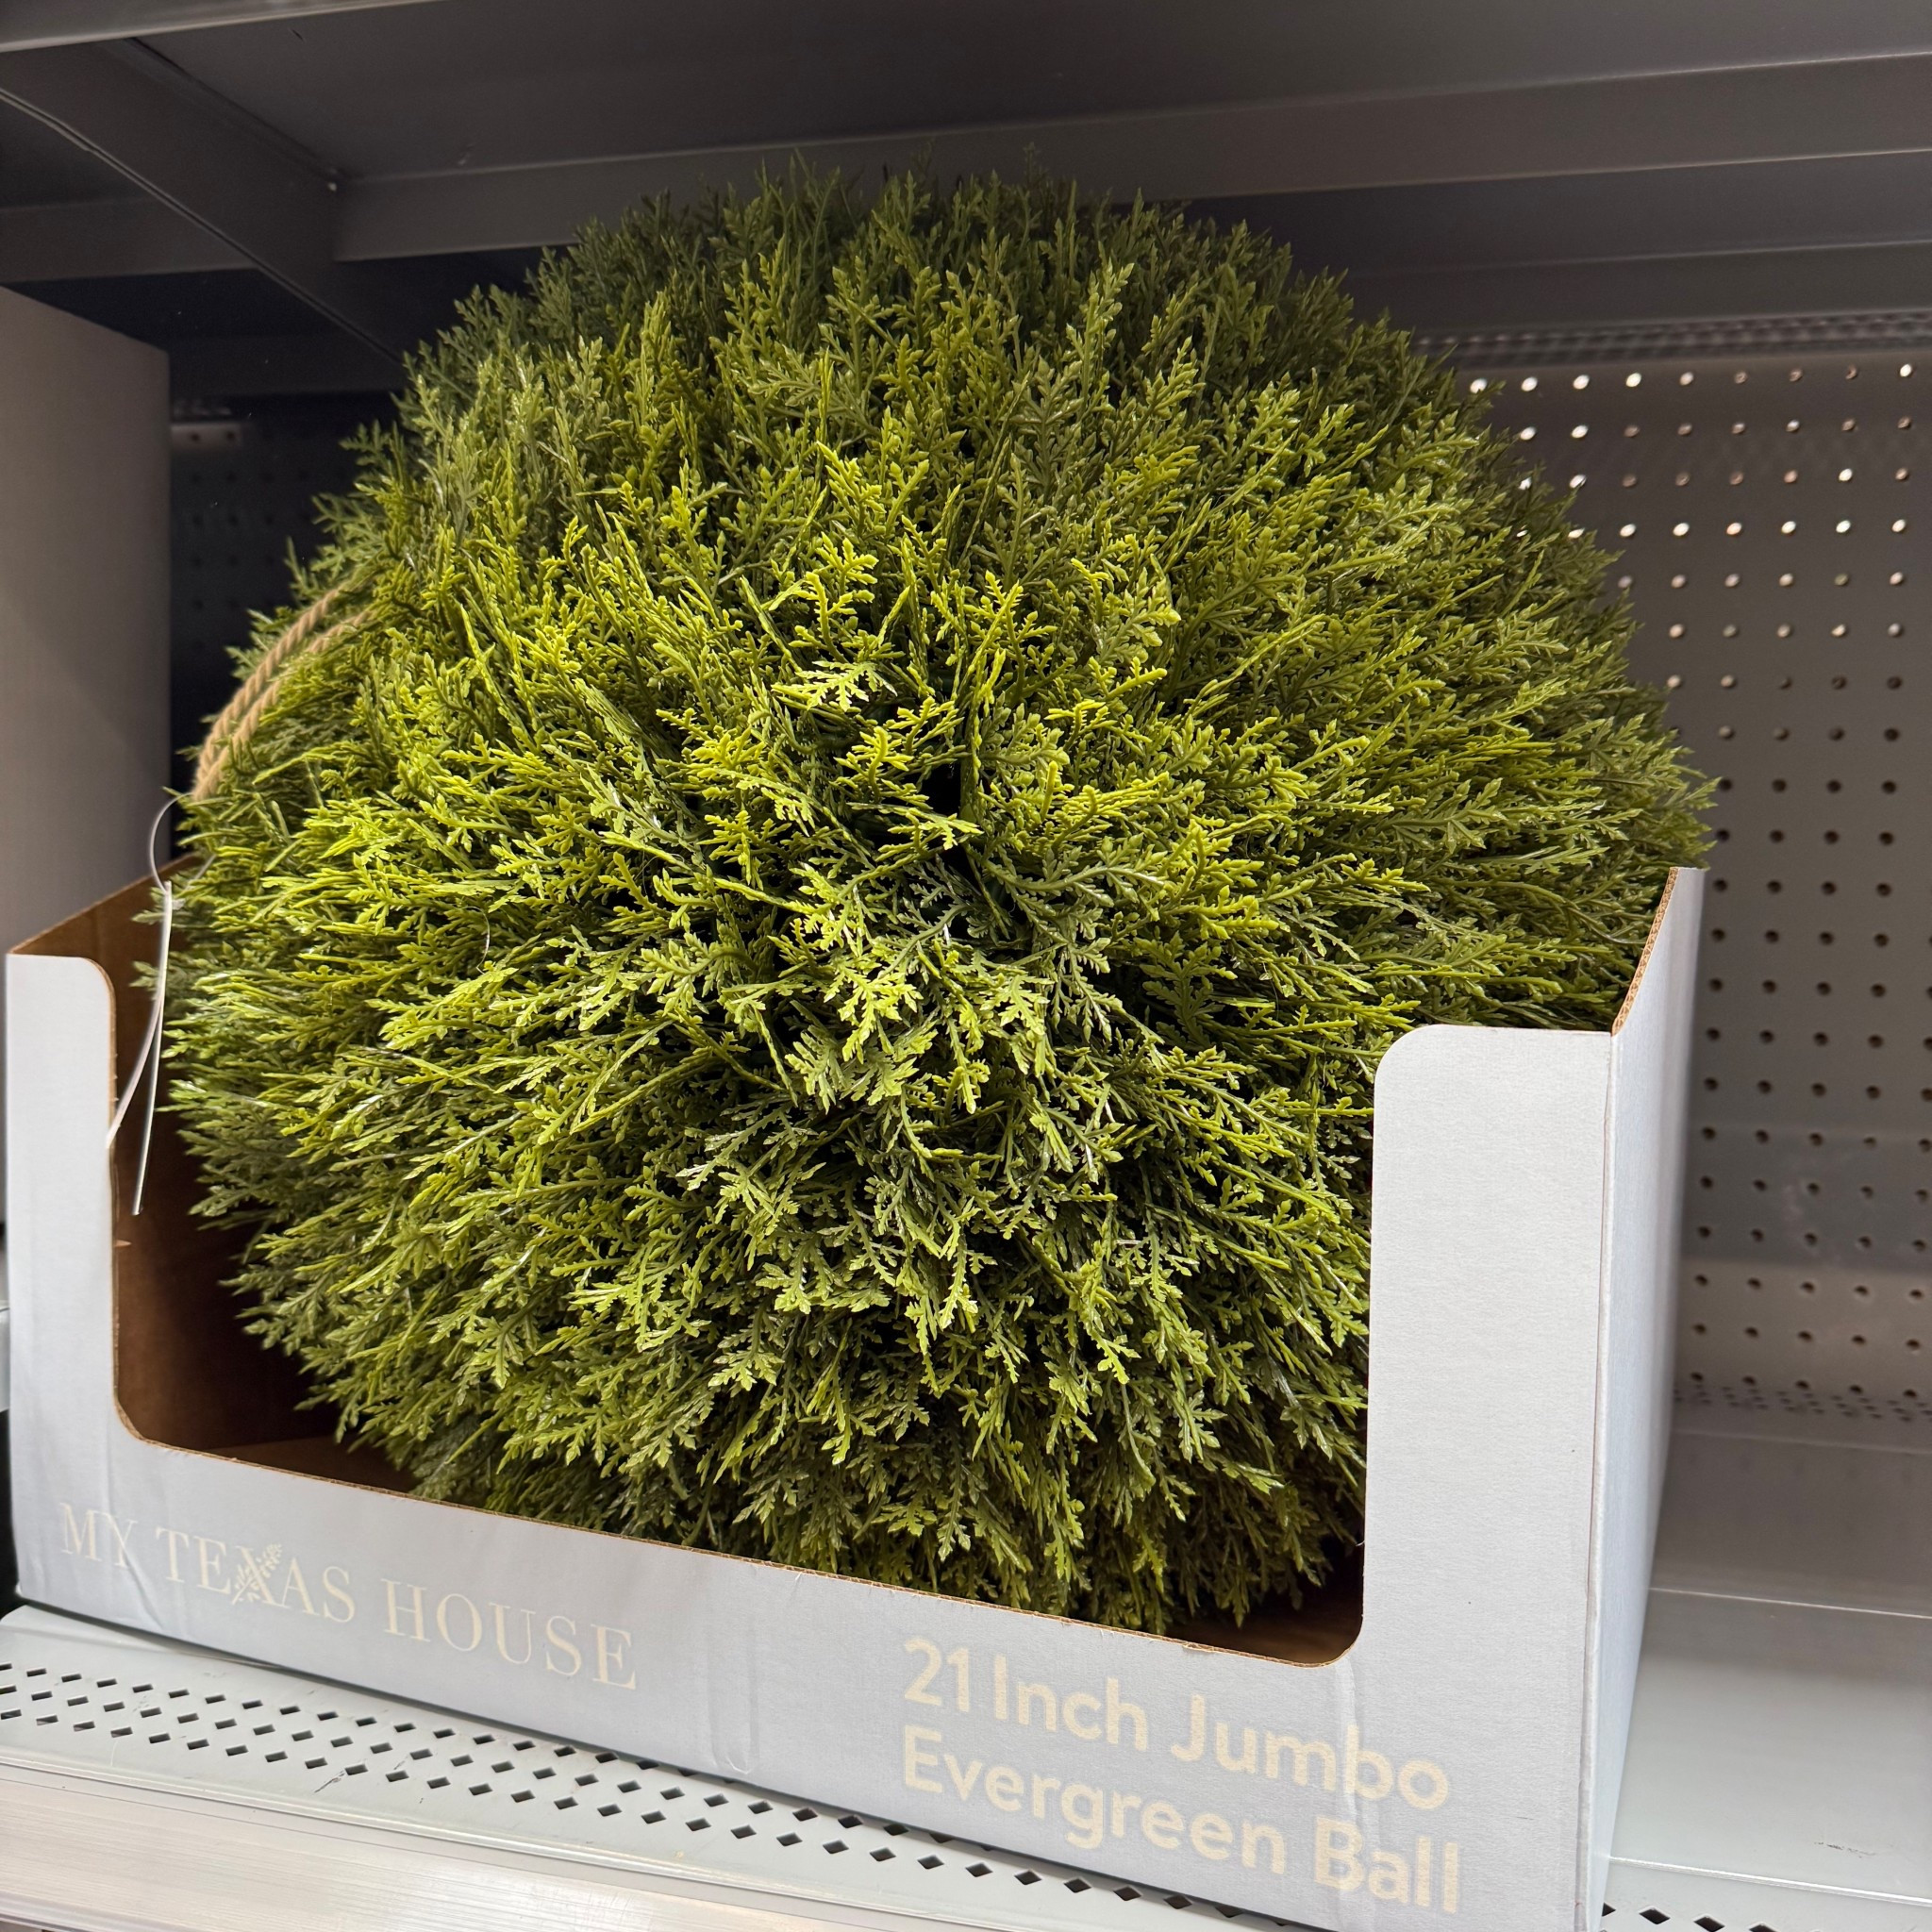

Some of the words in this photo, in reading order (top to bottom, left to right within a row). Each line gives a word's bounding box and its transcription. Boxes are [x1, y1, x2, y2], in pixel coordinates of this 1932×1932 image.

[59, 1502, 139, 1571] MY
[156, 1526, 357, 1624] TEXAS
[380, 1578, 637, 1690] HOUSE
[903, 1637, 971, 1713] 21
[992, 1655, 1149, 1753] Inch
[1170, 1693, 1450, 1810] Jumbo
[903, 1724, 1288, 1875] Evergreen
[1315, 1813, 1461, 1915] Ball
